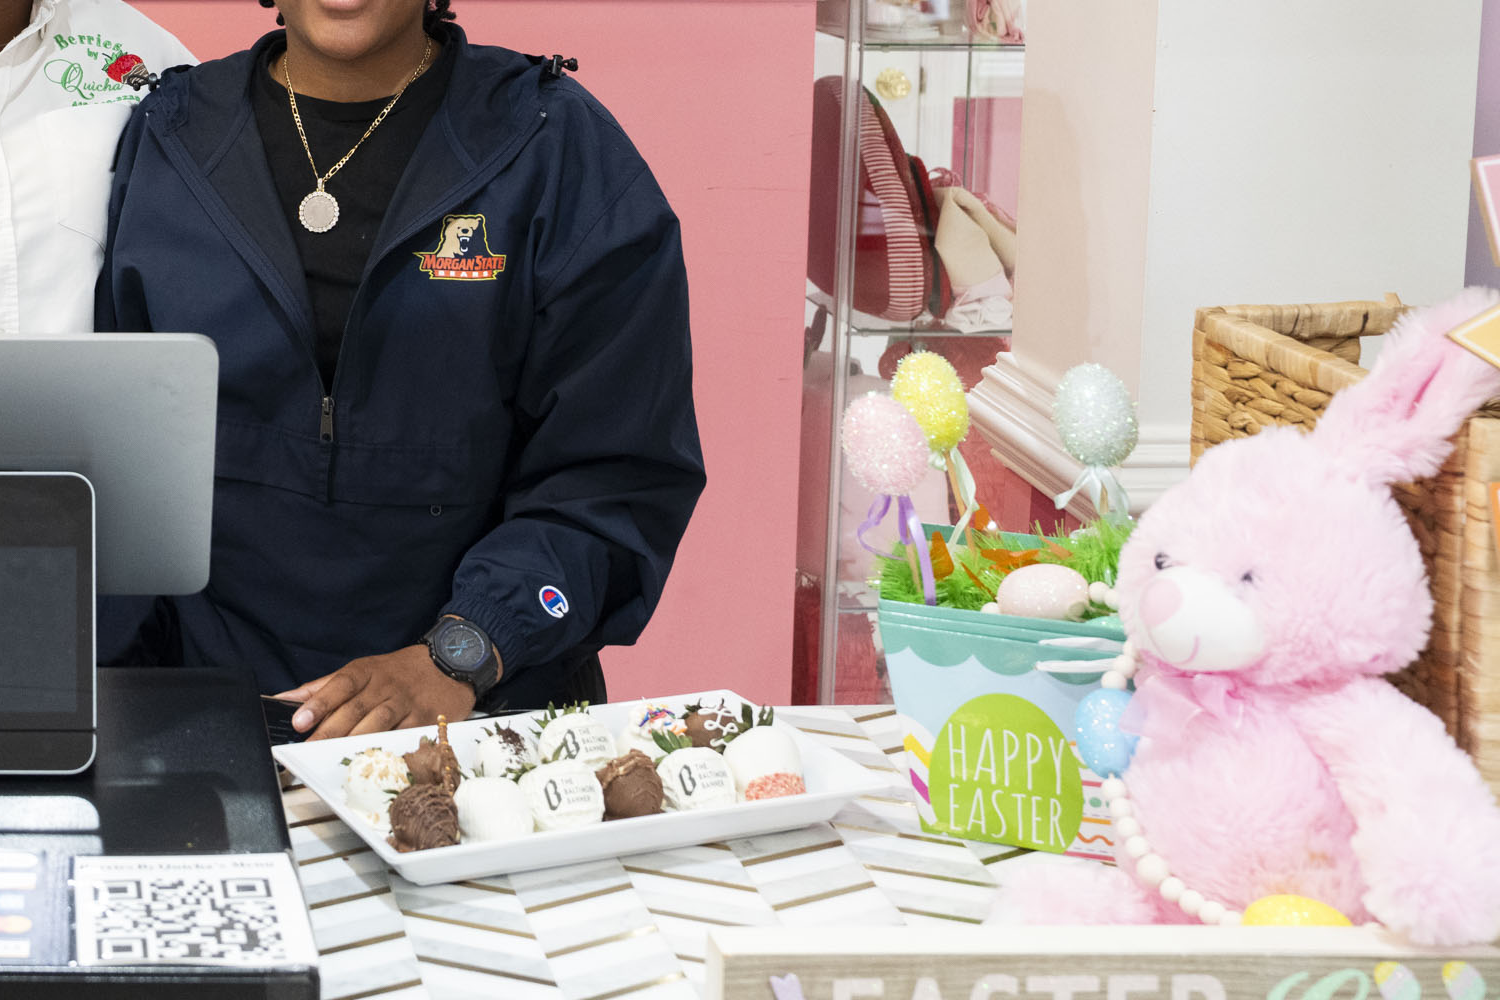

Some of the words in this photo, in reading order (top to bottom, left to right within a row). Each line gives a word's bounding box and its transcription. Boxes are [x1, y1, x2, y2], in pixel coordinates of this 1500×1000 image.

[53, 33, 124, 51] Berries
[87, 48, 99, 60] by
[43, 58, 124, 101] Quicha
[422, 254, 476, 270] MORGAN
[475, 255, 505, 270] STATE
[948, 722, 1065, 795] HAPPY
[948, 783, 1066, 848] EASTER
